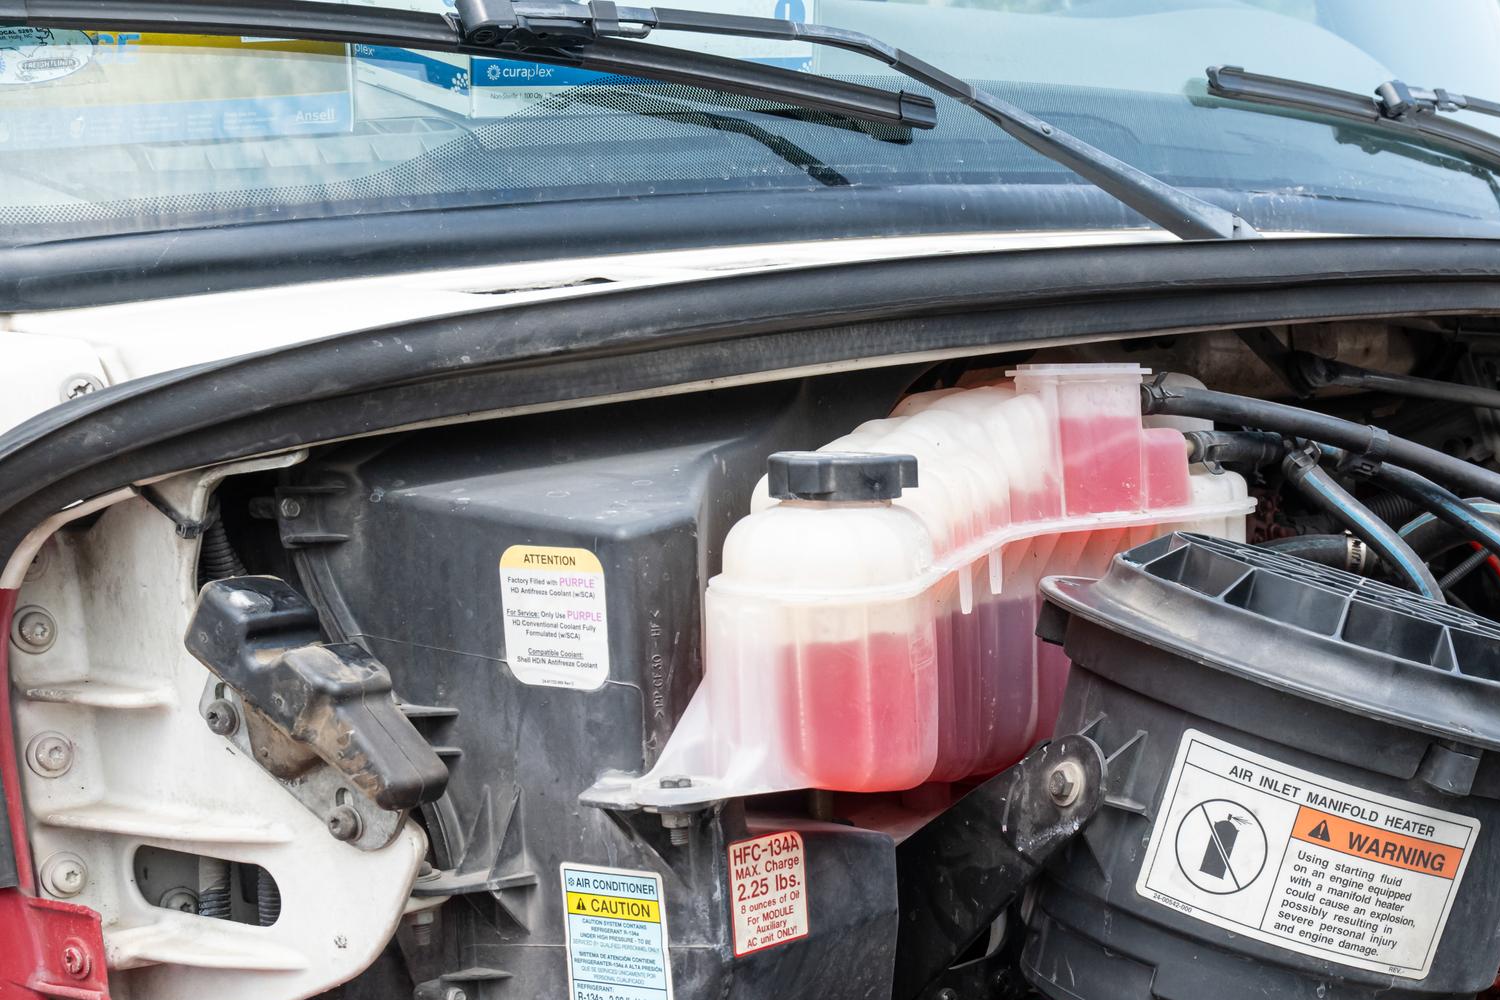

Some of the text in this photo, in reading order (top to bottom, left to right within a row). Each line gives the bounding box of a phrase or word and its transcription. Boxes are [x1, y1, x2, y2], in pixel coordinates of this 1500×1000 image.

[503, 64, 553, 79] curaplex
[295, 109, 336, 121] Ansell
[524, 554, 576, 566] ATTENTION
[507, 576, 529, 585] Factory
[560, 577, 595, 589] PURPLE
[521, 588, 548, 596] Antifreeze
[549, 589, 572, 597] Coolant
[517, 609, 540, 618] Service:
[540, 611, 554, 620] Only
[567, 610, 602, 622] PURPLE
[522, 620, 558, 629] Conventional
[560, 622, 581, 630] Coolant
[582, 624, 597, 632] Fully
[525, 629, 557, 638] Formulated
[528, 648, 559, 657] Compatible
[548, 658, 575, 667] Antifreeze
[576, 661, 598, 669] Coolant
[1229, 765, 1435, 837] AIR INLET MANIFOLD HEATER
[733, 834, 799, 866] HFC-134A
[1348, 831, 1446, 872] WARNING
[735, 856, 799, 881] MAX. Charge
[1297, 850, 1403, 887] Using starting fluid
[576, 878, 655, 895] AIR CONDITIONER
[738, 873, 801, 902] 2.25 lbs.
[1293, 863, 1412, 902] on an engine equipped
[1290, 874, 1405, 912] with a manifold heater
[591, 898, 651, 918] CAUTION
[741, 890, 800, 914] 8 ounces of Oil
[1285, 886, 1416, 928] could cause an explosion,
[747, 905, 794, 926] For MODULE
[1281, 898, 1393, 935] possibly resulting in
[582, 918, 647, 930] CAUTION SYSTEM CONTAINS
[591, 926, 622, 934] REFRIGERANT
[756, 919, 787, 934] Auxiliary
[1278, 910, 1397, 950] severe personal injury
[609, 935, 633, 943] PRESSURE
[747, 938, 758, 948] AC
[760, 933, 775, 944] unit
[1274, 921, 1379, 957] and engine damage.
[579, 951, 599, 959] SISTEMA
[632, 957, 656, 965] CONTIENE
[577, 983, 614, 993] REFRIGERANT:
